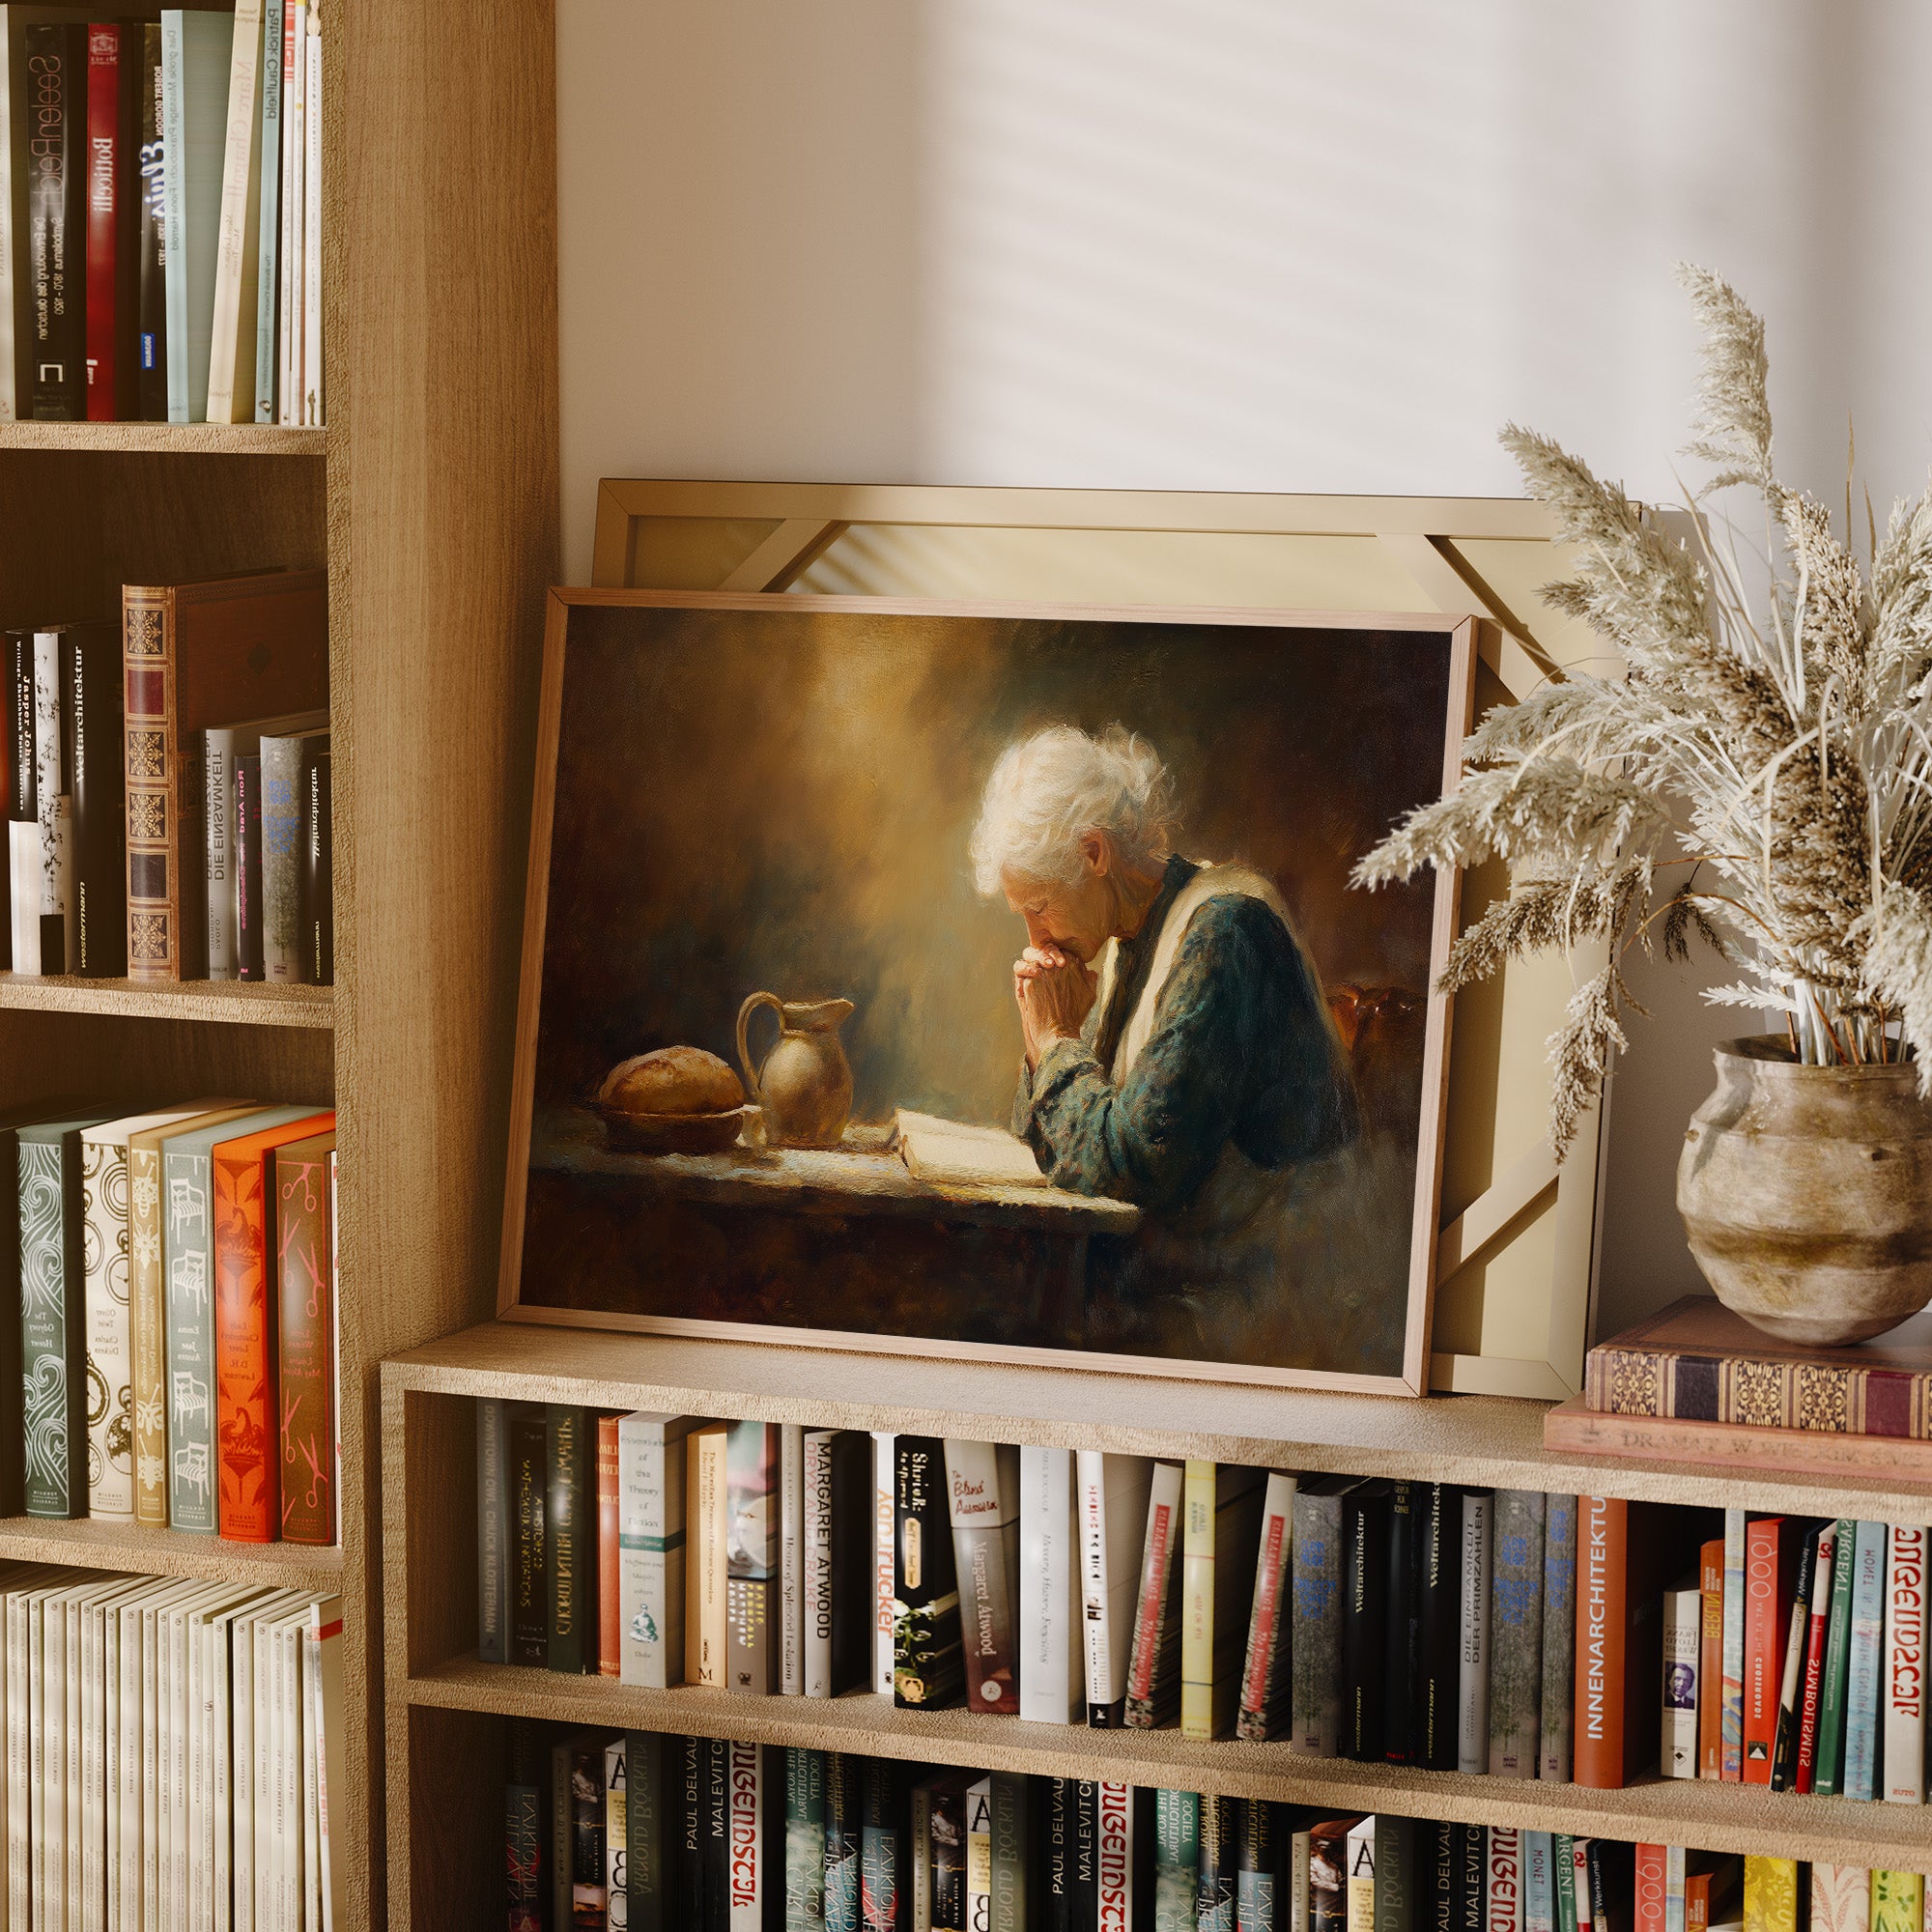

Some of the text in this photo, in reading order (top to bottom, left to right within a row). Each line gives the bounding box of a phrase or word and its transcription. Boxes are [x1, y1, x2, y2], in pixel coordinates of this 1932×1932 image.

[22, 676, 32, 775] Jasper Johns
[74, 645, 85, 782] Weltarchitektur
[485, 1406, 497, 1504] DOWNTOWN OWL
[954, 1480, 983, 1496] Blind
[485, 1510, 497, 1632] CHUCK KLOSTERMAN
[806, 1441, 816, 1611] ORYX AND CRAKE
[817, 1442, 830, 1639] MARGARET ATWOOD
[1355, 1511, 1364, 1613] Weltarchitektur
[1464, 1521, 1473, 1628] EINSAMKEIT
[1473, 1506, 1483, 1621] PRIMZAHLEN
[972, 1541, 997, 1656] Margaret Atwood
[687, 1807, 697, 1850] PAUL
[1053, 1851, 1064, 1894] PAUL
[1533, 1850, 1545, 1885] MONET
[1592, 1861, 1604, 1908] Werkkunst
[1636, 1856, 1662, 1919] 1900
